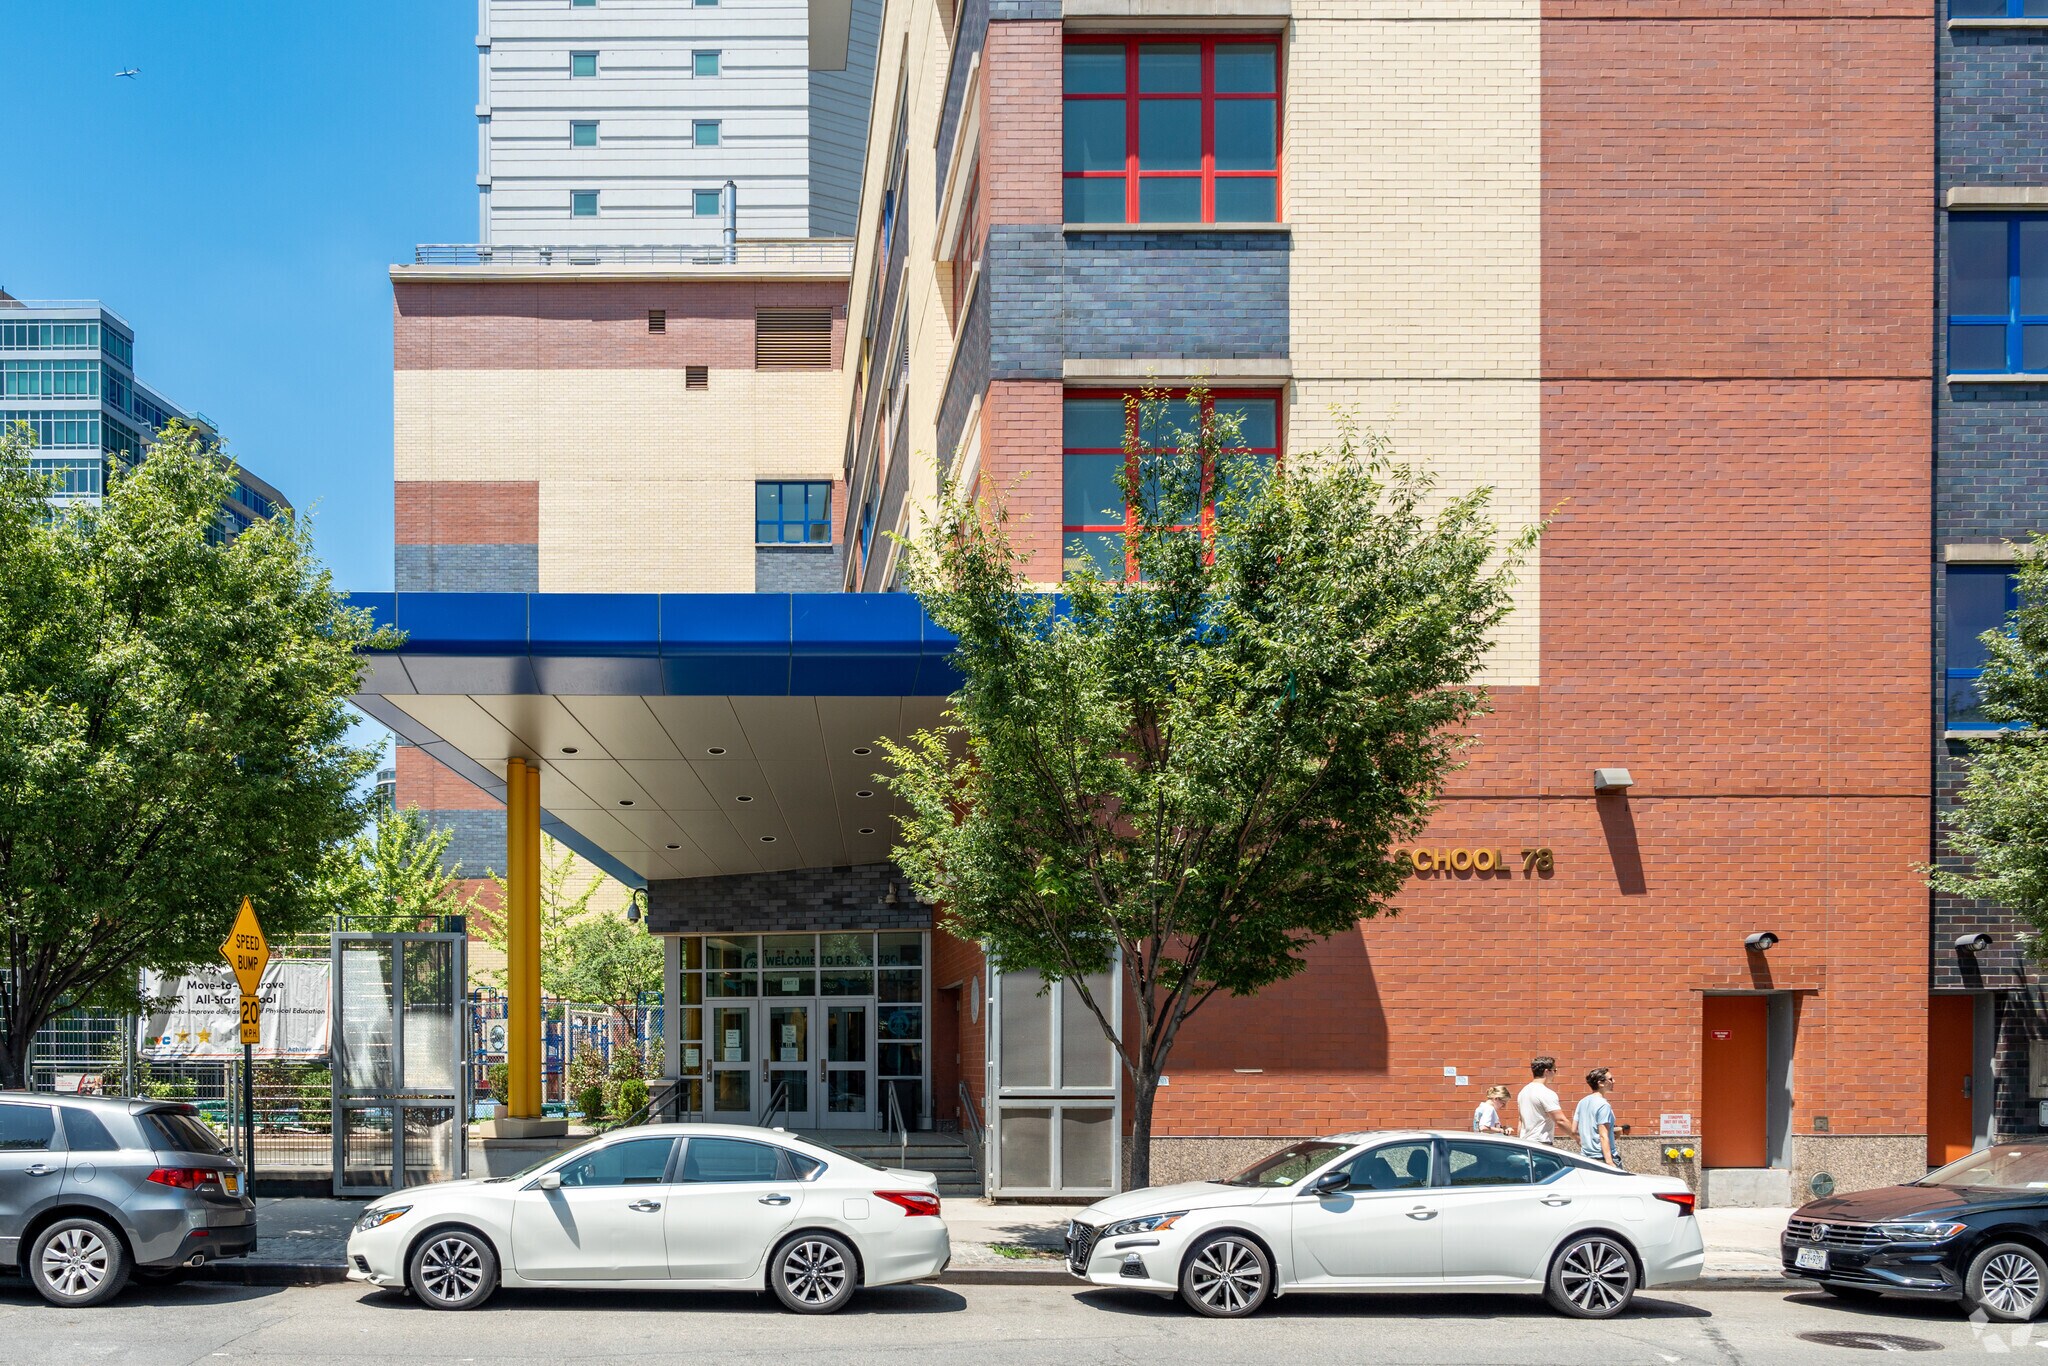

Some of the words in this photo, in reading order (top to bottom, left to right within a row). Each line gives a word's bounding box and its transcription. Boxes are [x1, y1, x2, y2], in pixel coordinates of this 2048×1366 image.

[1521, 847, 1554, 871] 78
[236, 934, 259, 951] SPEED
[238, 955, 258, 971] BUMP
[766, 956, 815, 966] WELCOME
[187, 981, 285, 990] Move-to-rove
[196, 994, 236, 1005] All-Star
[241, 1000, 258, 1025] 20
